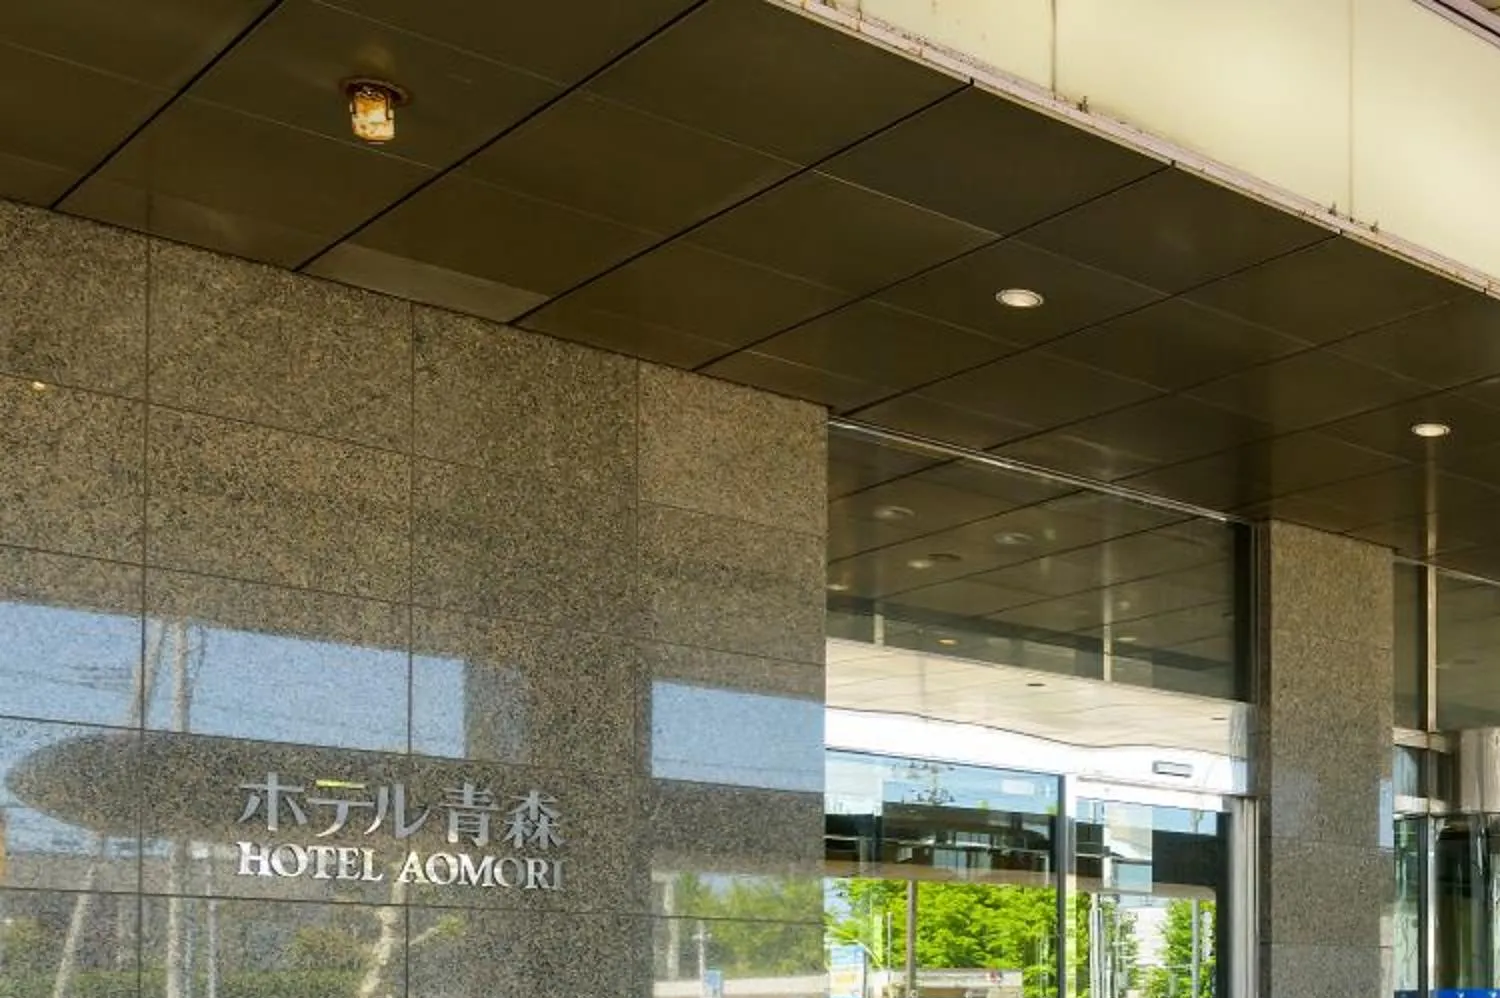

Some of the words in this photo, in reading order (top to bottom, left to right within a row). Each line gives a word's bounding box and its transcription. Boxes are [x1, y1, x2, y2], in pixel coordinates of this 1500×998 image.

[237, 771, 567, 850] ホテル青森
[236, 841, 383, 883] HOTEL
[398, 850, 566, 891] AOMORI
